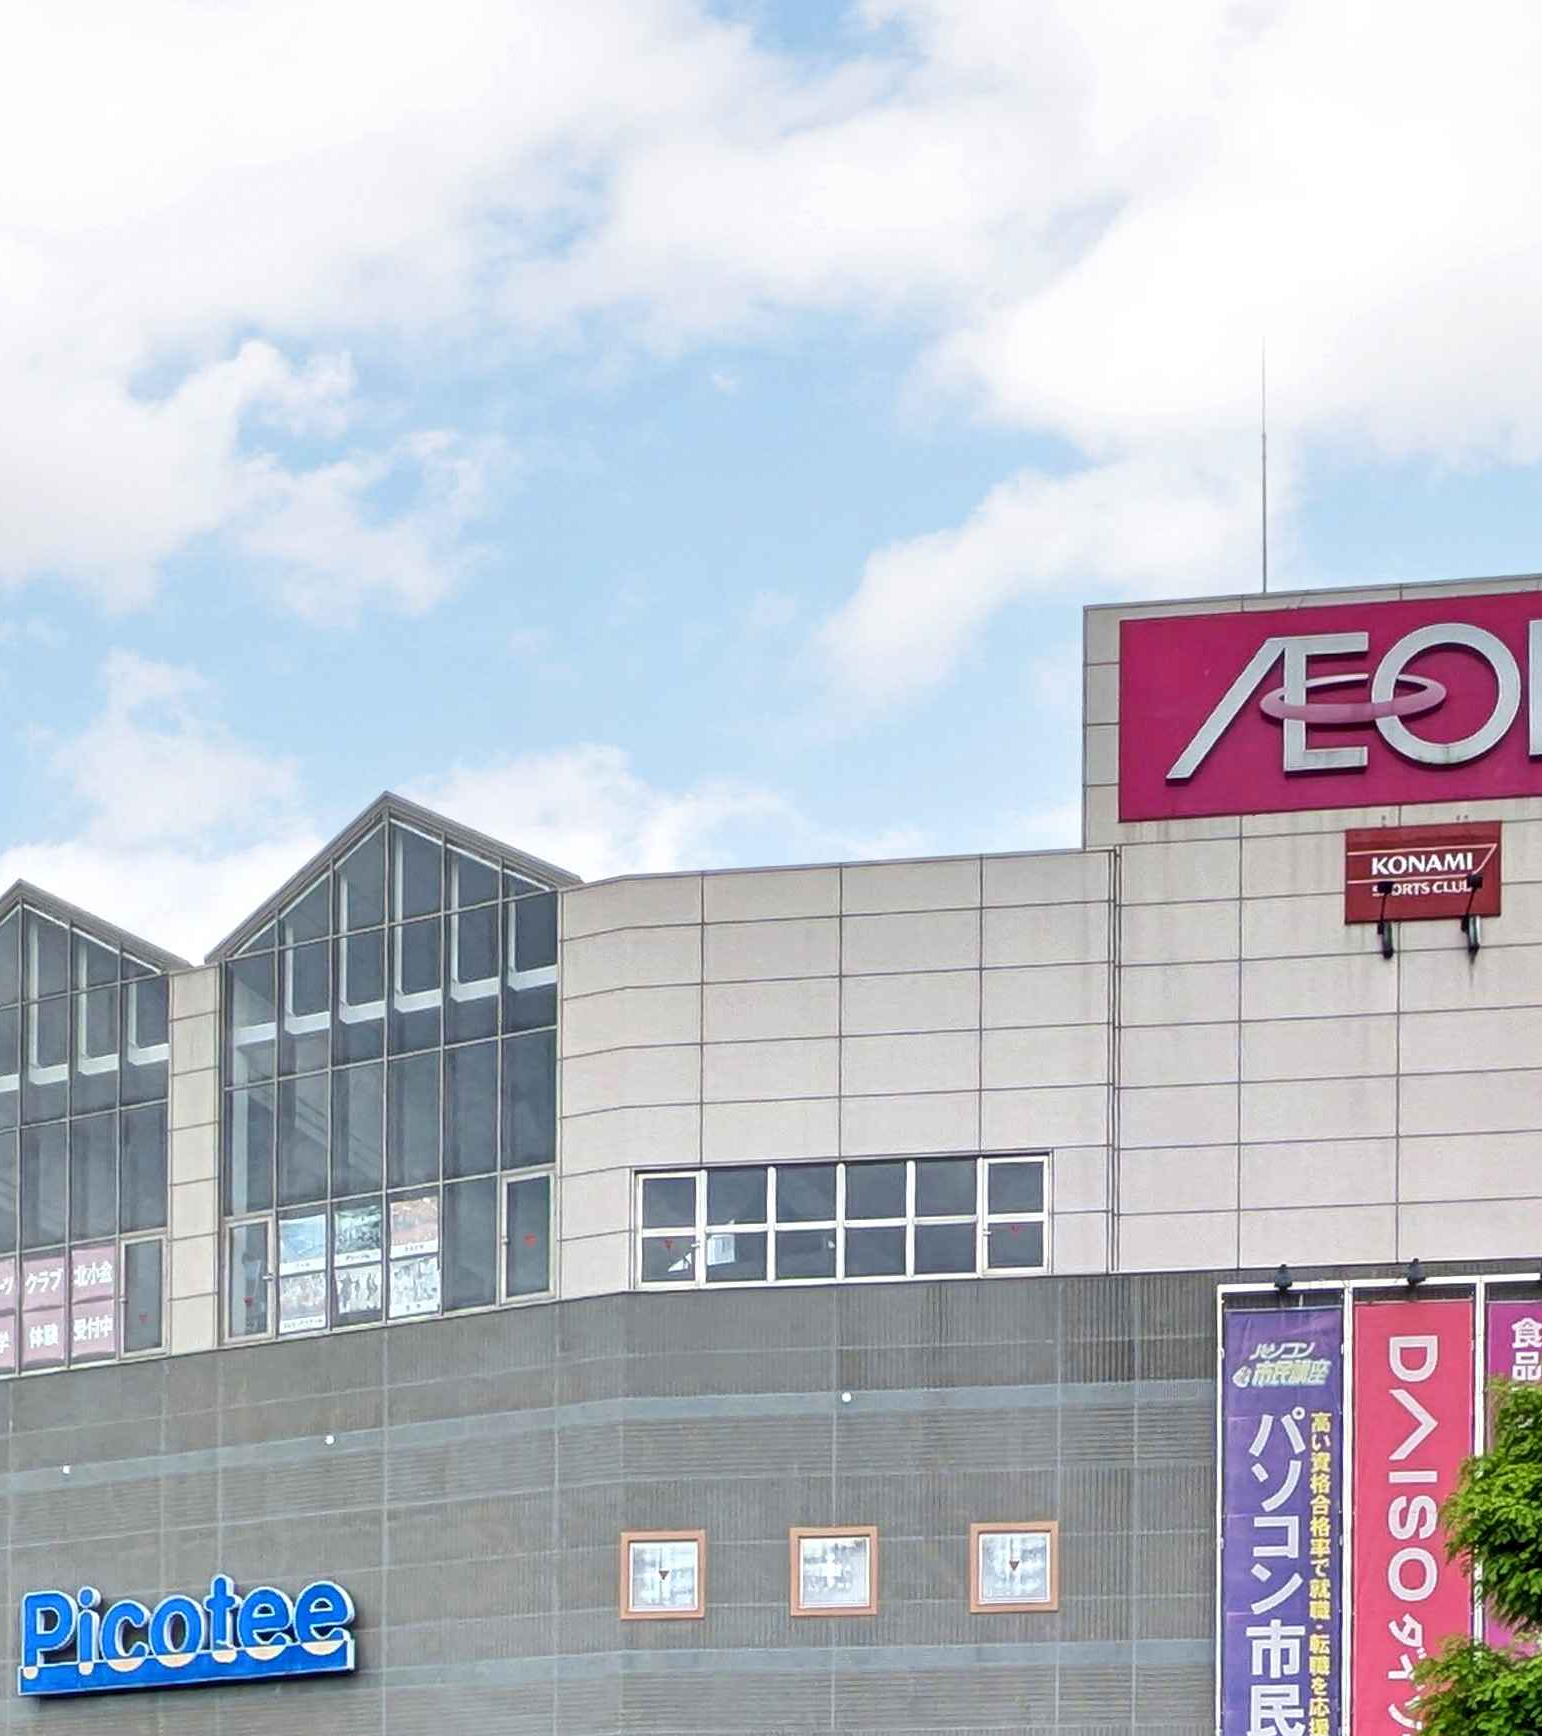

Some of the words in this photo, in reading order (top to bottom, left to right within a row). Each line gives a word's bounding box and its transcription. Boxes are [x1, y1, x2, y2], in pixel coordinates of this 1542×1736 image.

[1372, 852, 1473, 875] KONAMI
[25, 1268, 63, 1294] クラブ
[74, 1260, 113, 1287] 北小金
[29, 1322, 59, 1349] 体験
[73, 1315, 114, 1342] 受付中
[1388, 1335, 1438, 1601] DAISO
[20, 1573, 355, 1680] Picotee
